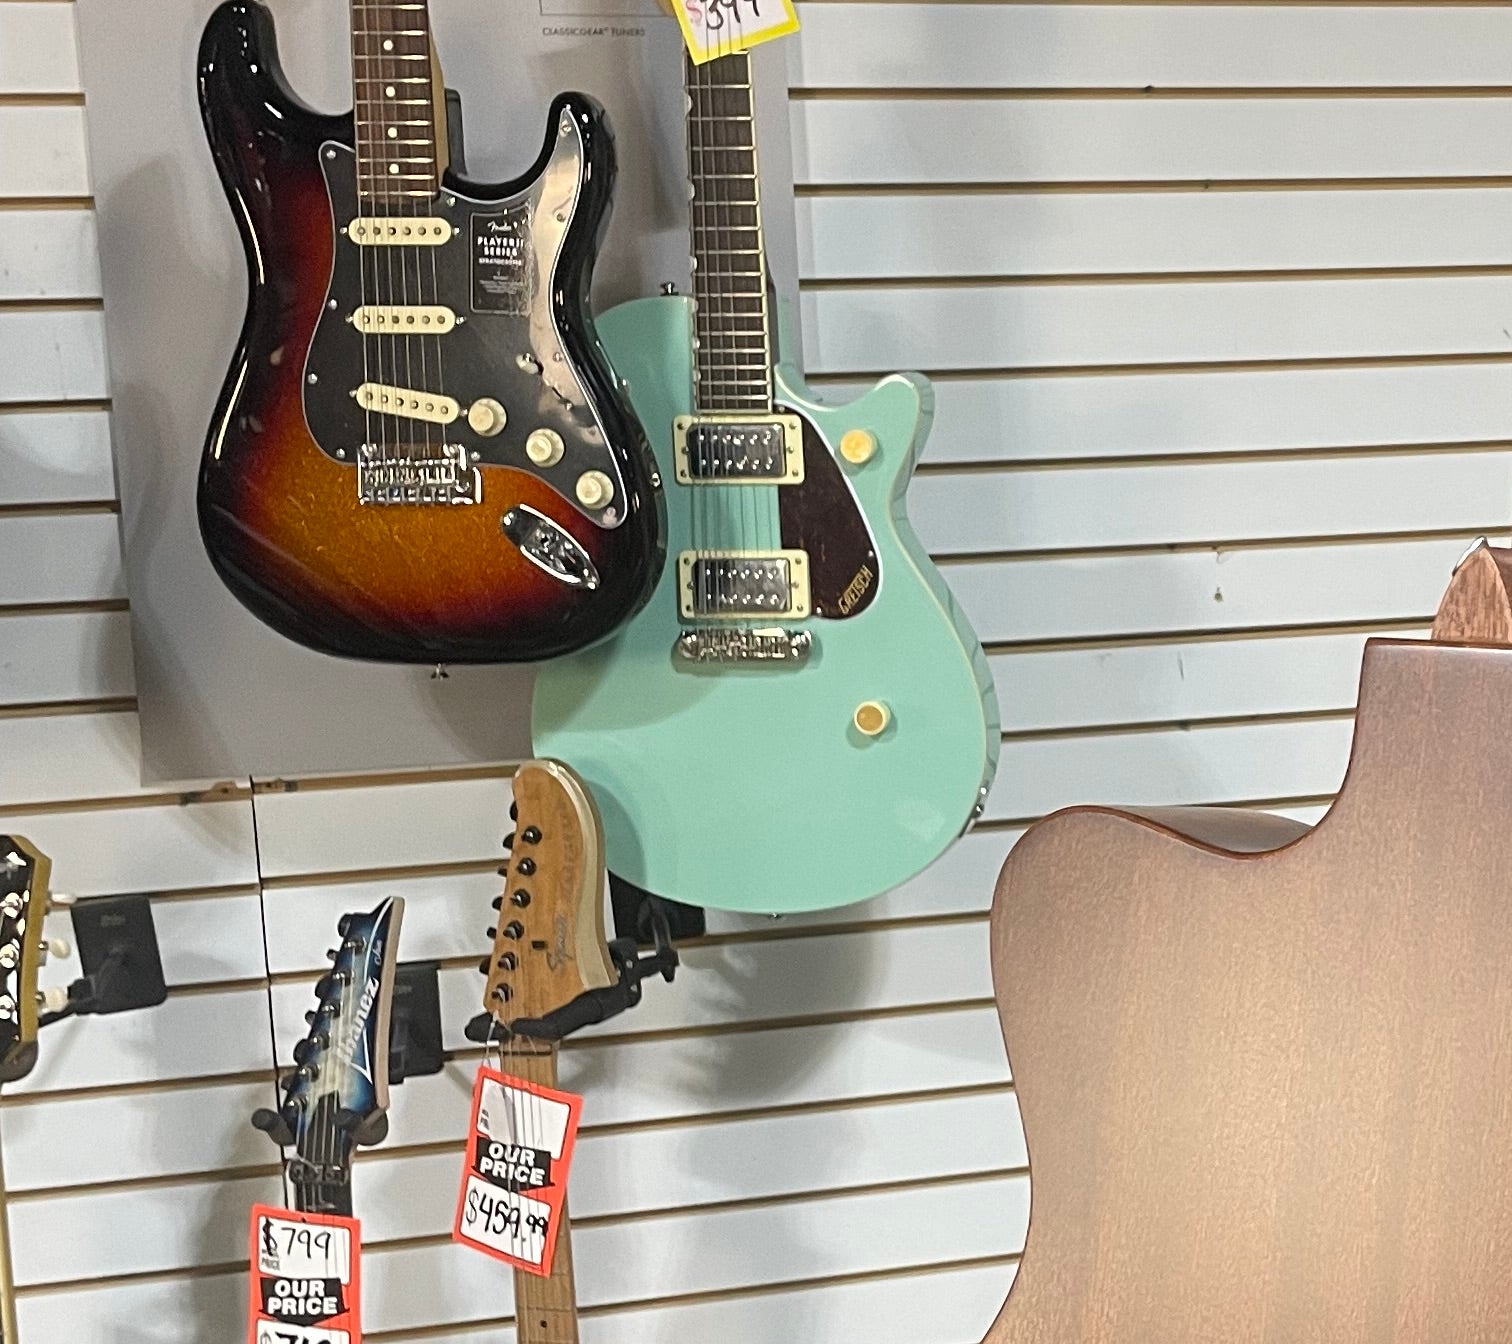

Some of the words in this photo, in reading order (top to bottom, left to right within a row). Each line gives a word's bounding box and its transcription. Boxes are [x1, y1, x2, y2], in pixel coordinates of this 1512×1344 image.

[838, 564, 874, 615] GRETSCH
[488, 1140, 536, 1167] OUR
[479, 1156, 546, 1187] PRICE
[274, 1279, 326, 1298] OUR
[267, 1296, 339, 1316] PRICE
